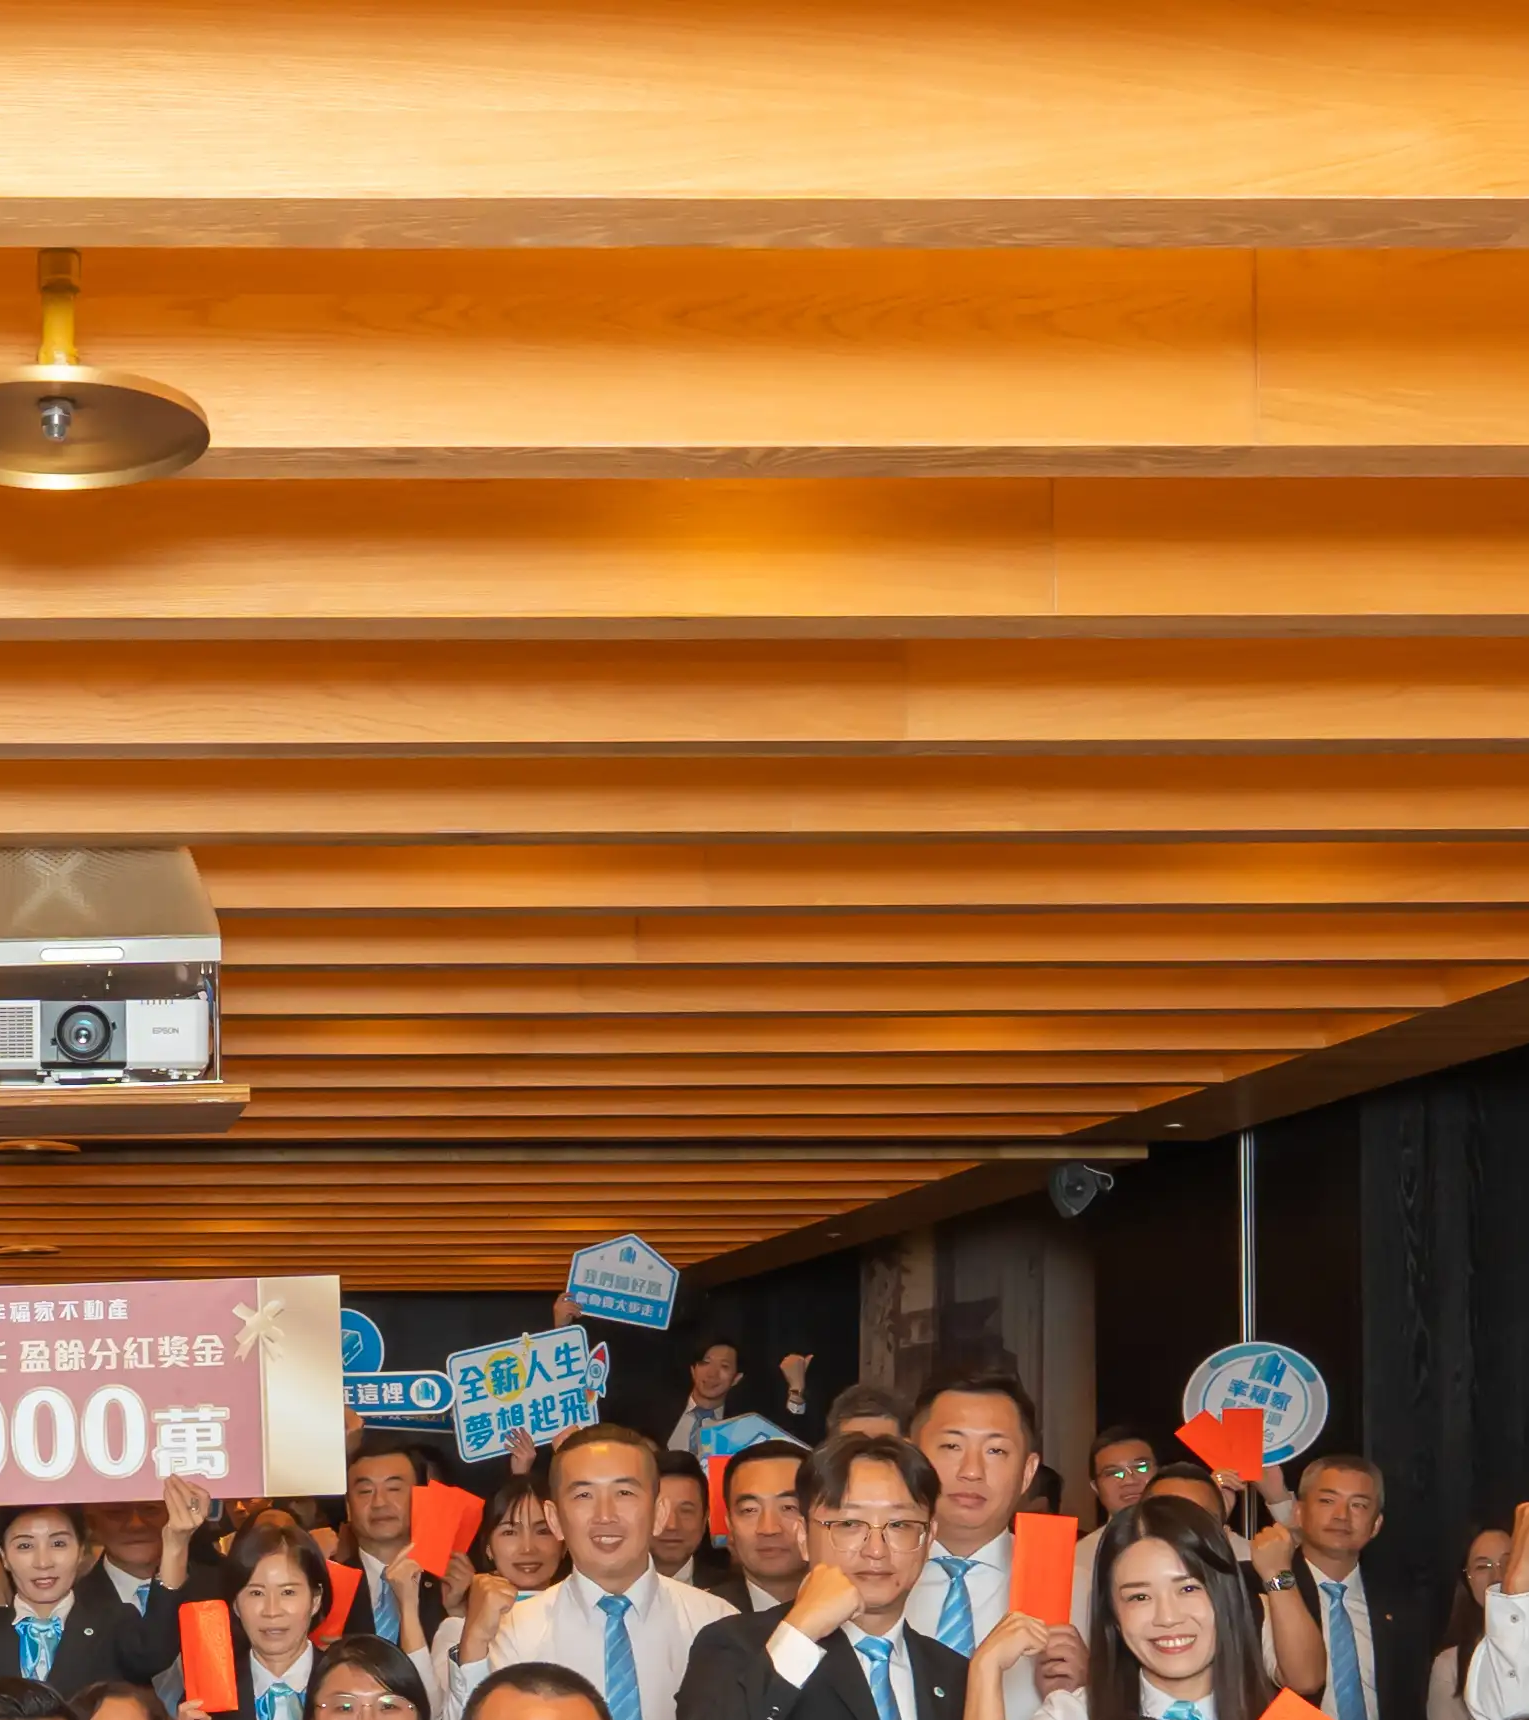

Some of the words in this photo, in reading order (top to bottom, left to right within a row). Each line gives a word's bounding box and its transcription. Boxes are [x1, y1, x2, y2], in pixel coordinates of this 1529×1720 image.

[152, 1027, 179, 1035] EPSON
[20, 1334, 225, 1374] 盈餘分紅獎金
[458, 1342, 585, 1405] 全薪人生
[465, 1387, 591, 1452] 夢想起飛
